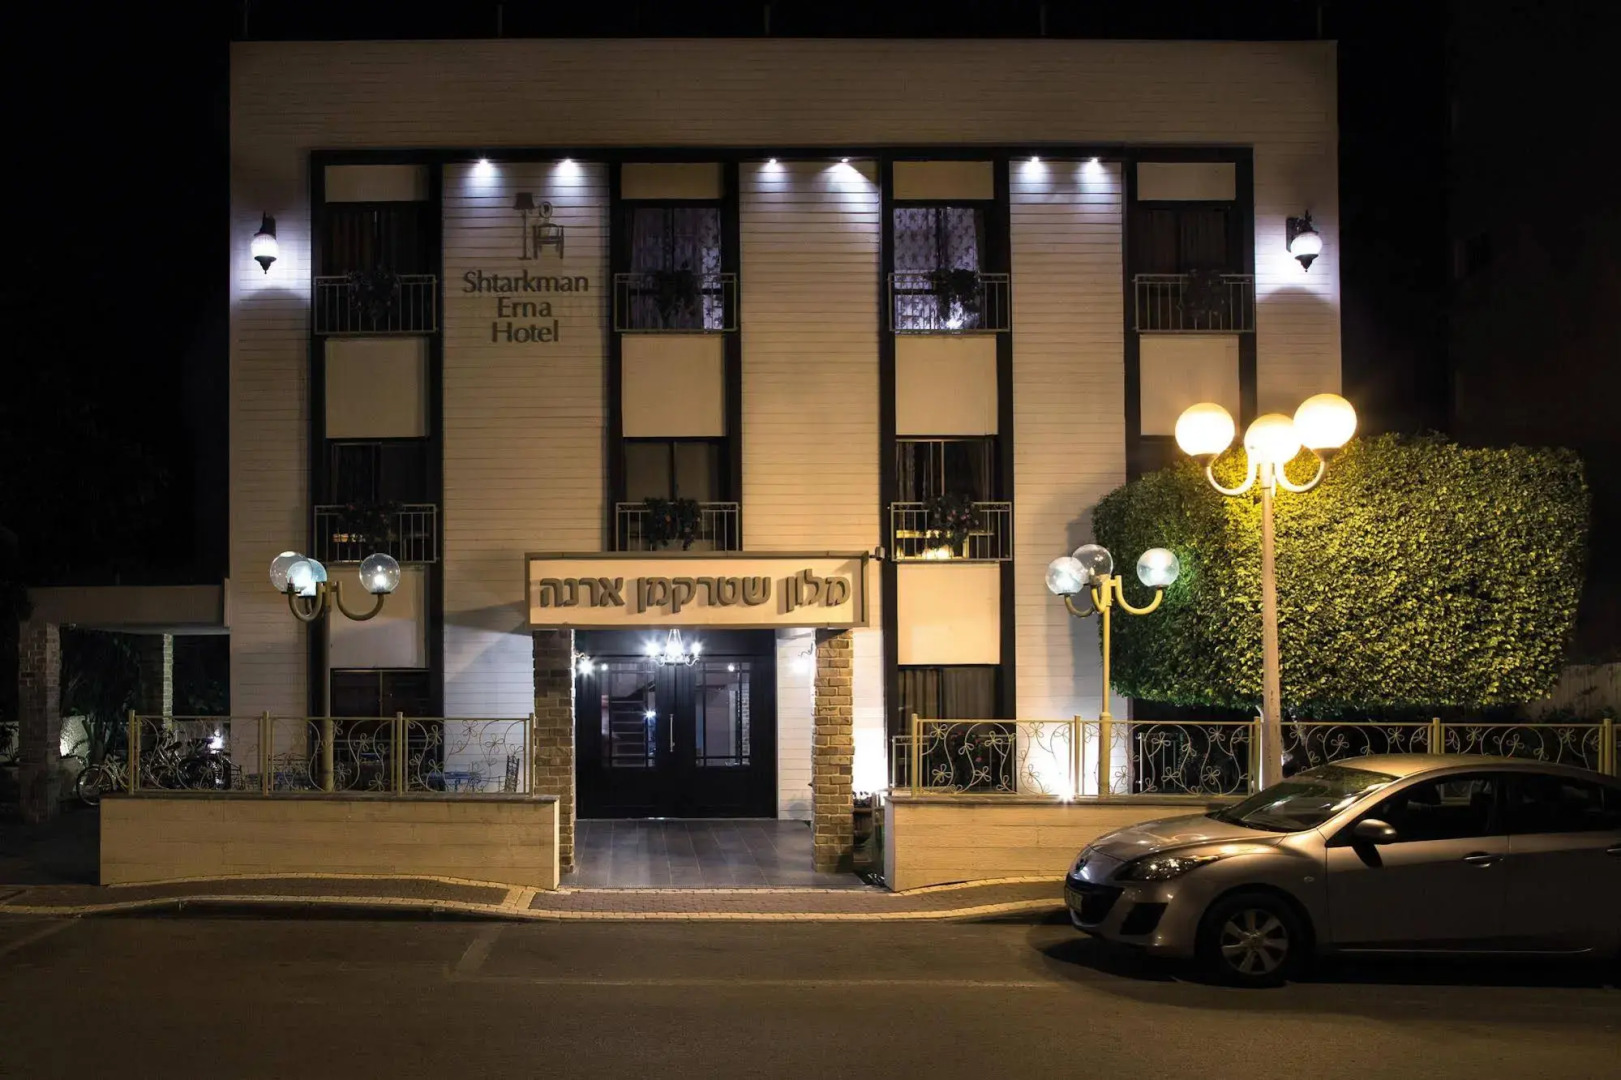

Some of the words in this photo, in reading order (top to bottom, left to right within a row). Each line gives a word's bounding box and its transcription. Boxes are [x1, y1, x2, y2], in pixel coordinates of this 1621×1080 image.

[462, 269, 589, 293] Shtarkman
[497, 296, 552, 318] Erna
[491, 320, 559, 343] Hotel
[539, 576, 625, 608] ארנה
[637, 575, 772, 614] שטרקמן
[785, 568, 851, 614] מלון
